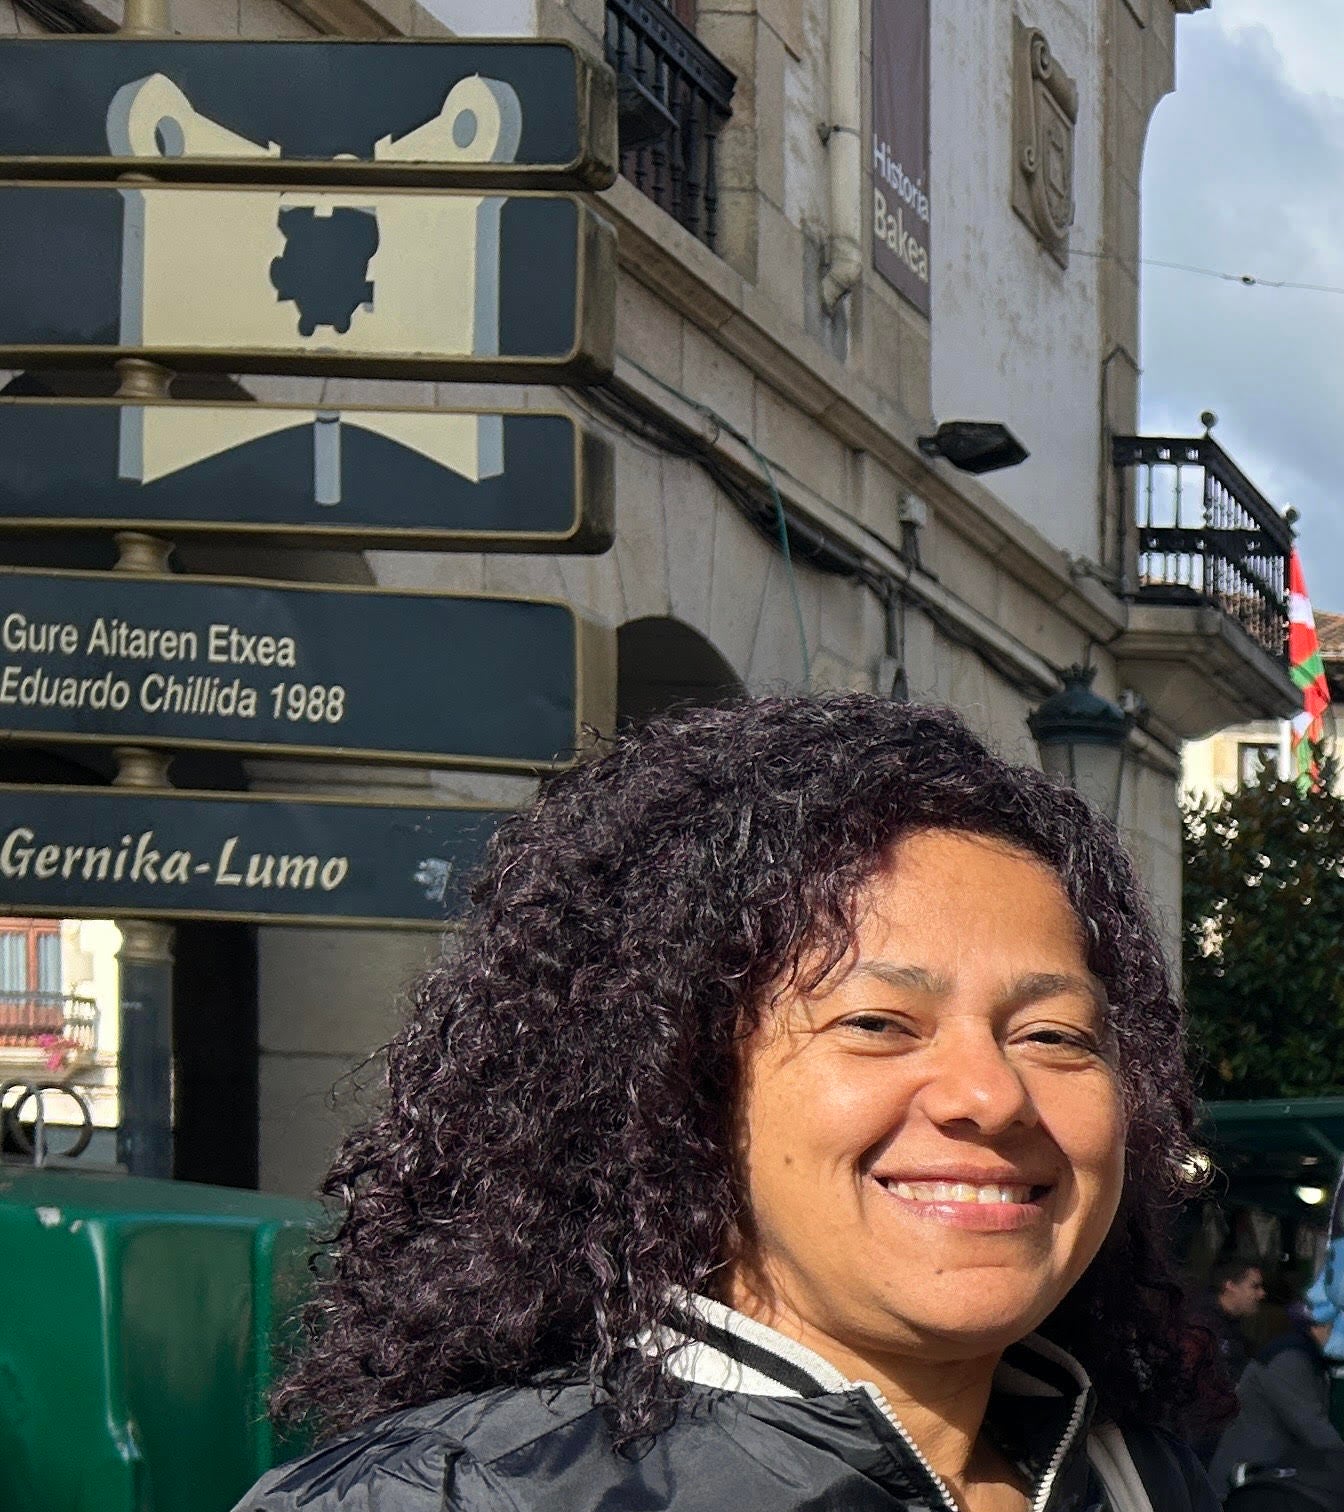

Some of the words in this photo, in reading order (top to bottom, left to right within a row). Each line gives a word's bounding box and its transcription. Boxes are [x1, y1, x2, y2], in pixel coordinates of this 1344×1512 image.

[3, 613, 78, 655] Gure
[86, 618, 197, 660] Aitaren
[208, 625, 296, 667] Etxea
[0, 666, 130, 711] Eduardo
[140, 673, 257, 718] Chillida
[271, 682, 346, 724] 1988
[0, 827, 348, 892] Gernika-Lumo
